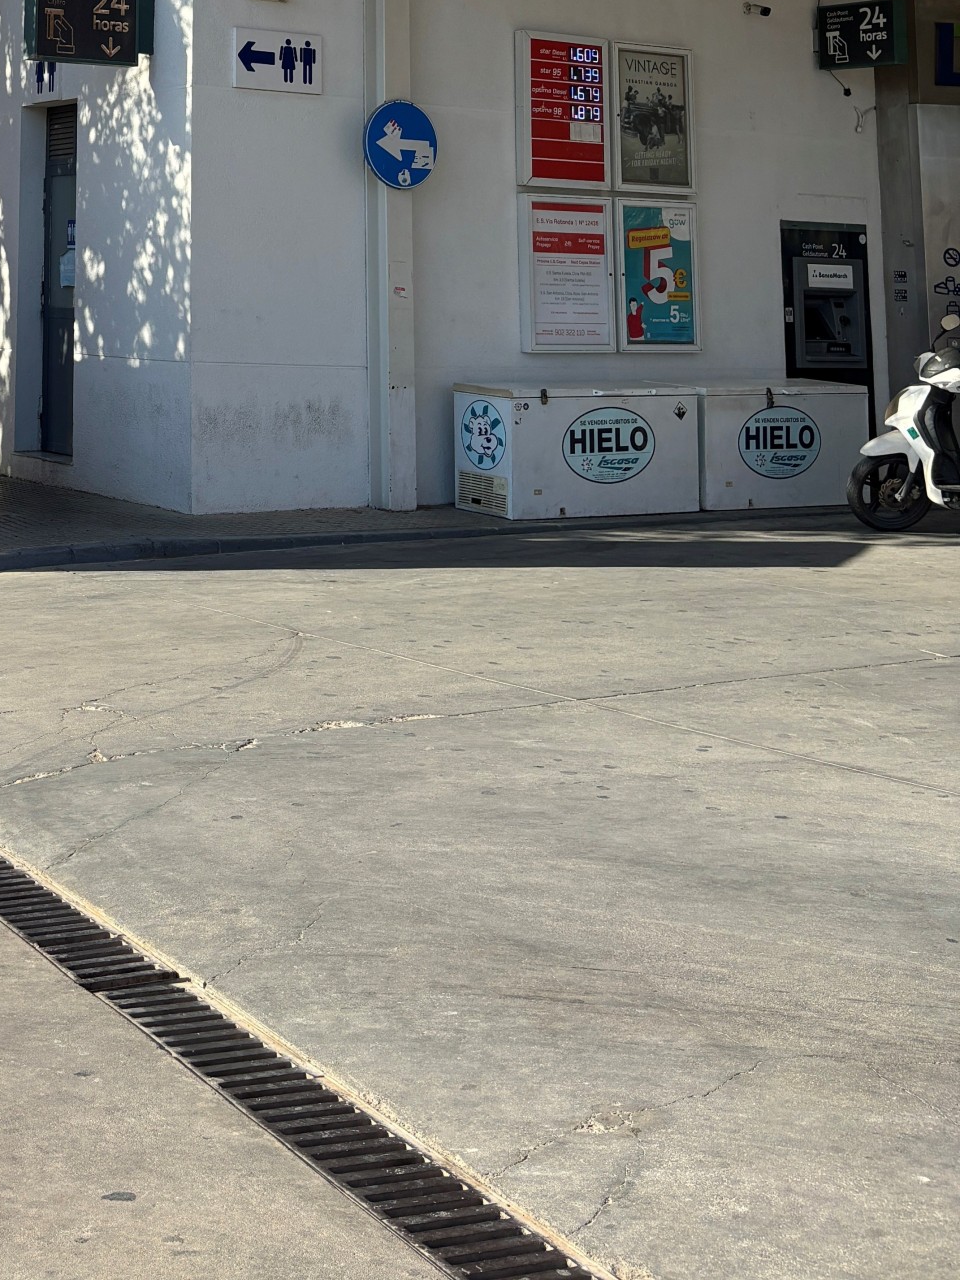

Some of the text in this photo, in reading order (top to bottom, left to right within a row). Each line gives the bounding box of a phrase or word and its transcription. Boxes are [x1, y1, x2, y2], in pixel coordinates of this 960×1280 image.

[93, 15, 129, 33] horas
[859, 6, 887, 30] 24
[860, 30, 887, 42] horas
[570, 47, 599, 63] 1.609
[570, 67, 599, 82] 1.739
[625, 58, 677, 76] VINTAGE
[571, 86, 600, 102] 1.679
[571, 105, 600, 121] 1.879
[831, 243, 847, 258] 24
[644, 245, 687, 305] 5 €
[669, 305, 680, 323] 5
[569, 426, 648, 454] HIELO
[745, 424, 815, 450] HIELO
